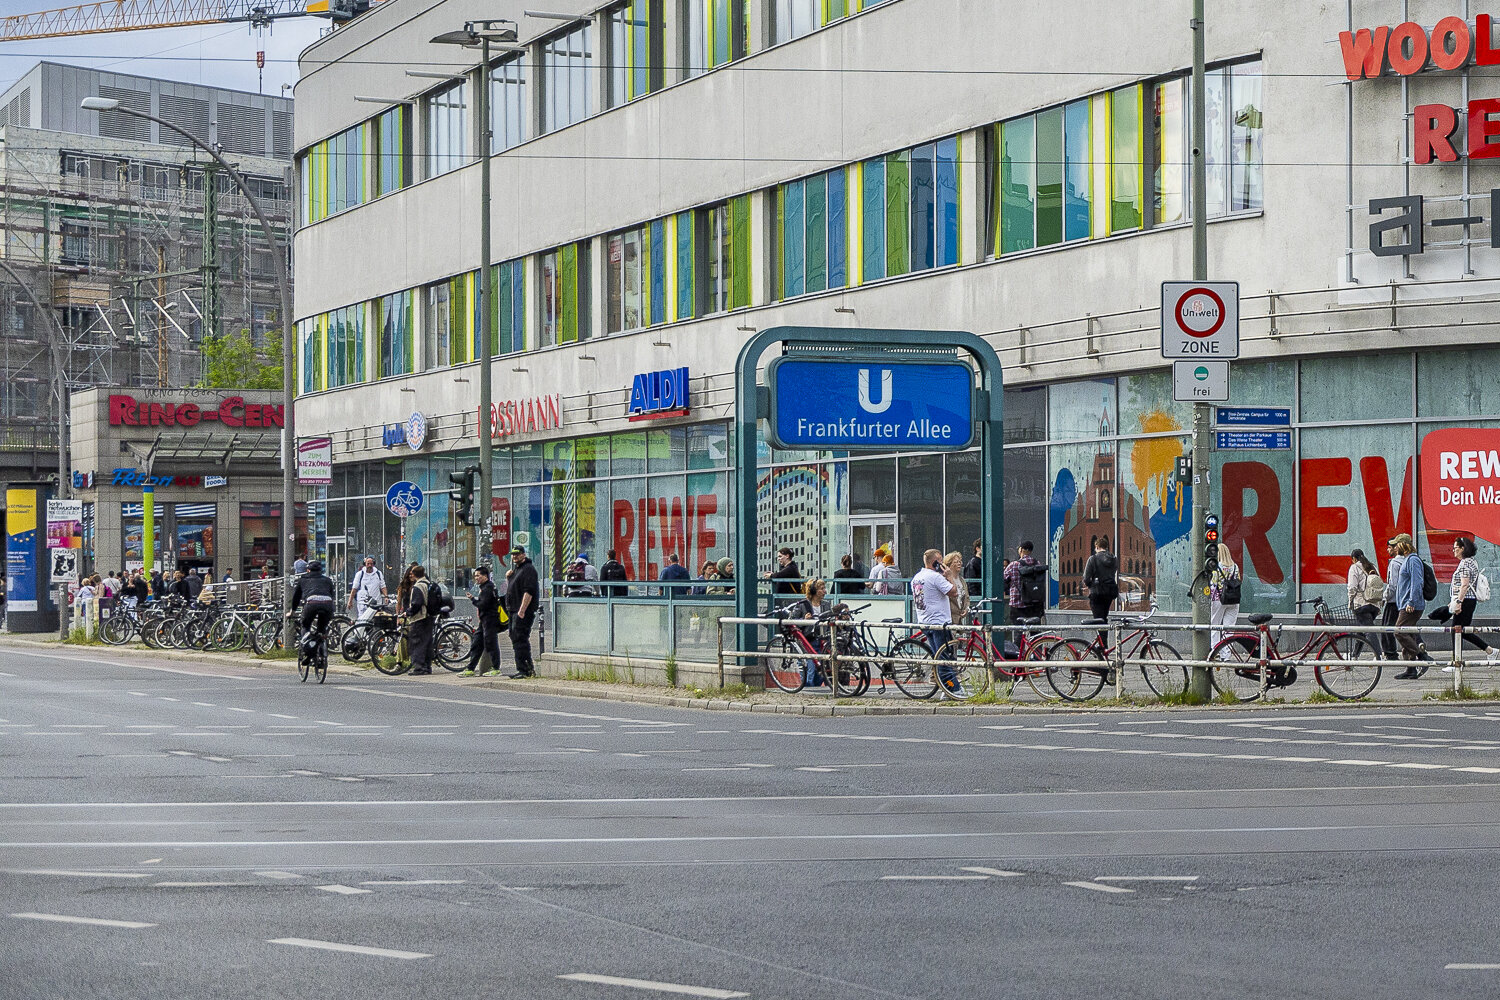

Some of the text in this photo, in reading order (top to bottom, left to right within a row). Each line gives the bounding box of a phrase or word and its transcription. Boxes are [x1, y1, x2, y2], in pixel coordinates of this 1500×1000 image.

[1181, 341, 1220, 354] ZONE
[629, 367, 690, 415] ALDI
[858, 368, 893, 414] U
[1193, 387, 1211, 396] frei
[477, 393, 564, 439] OSSMANN
[798, 418, 952, 439] Frankfurter Allee
[1439, 486, 1475, 506] Dein
[613, 494, 718, 581] REWE
